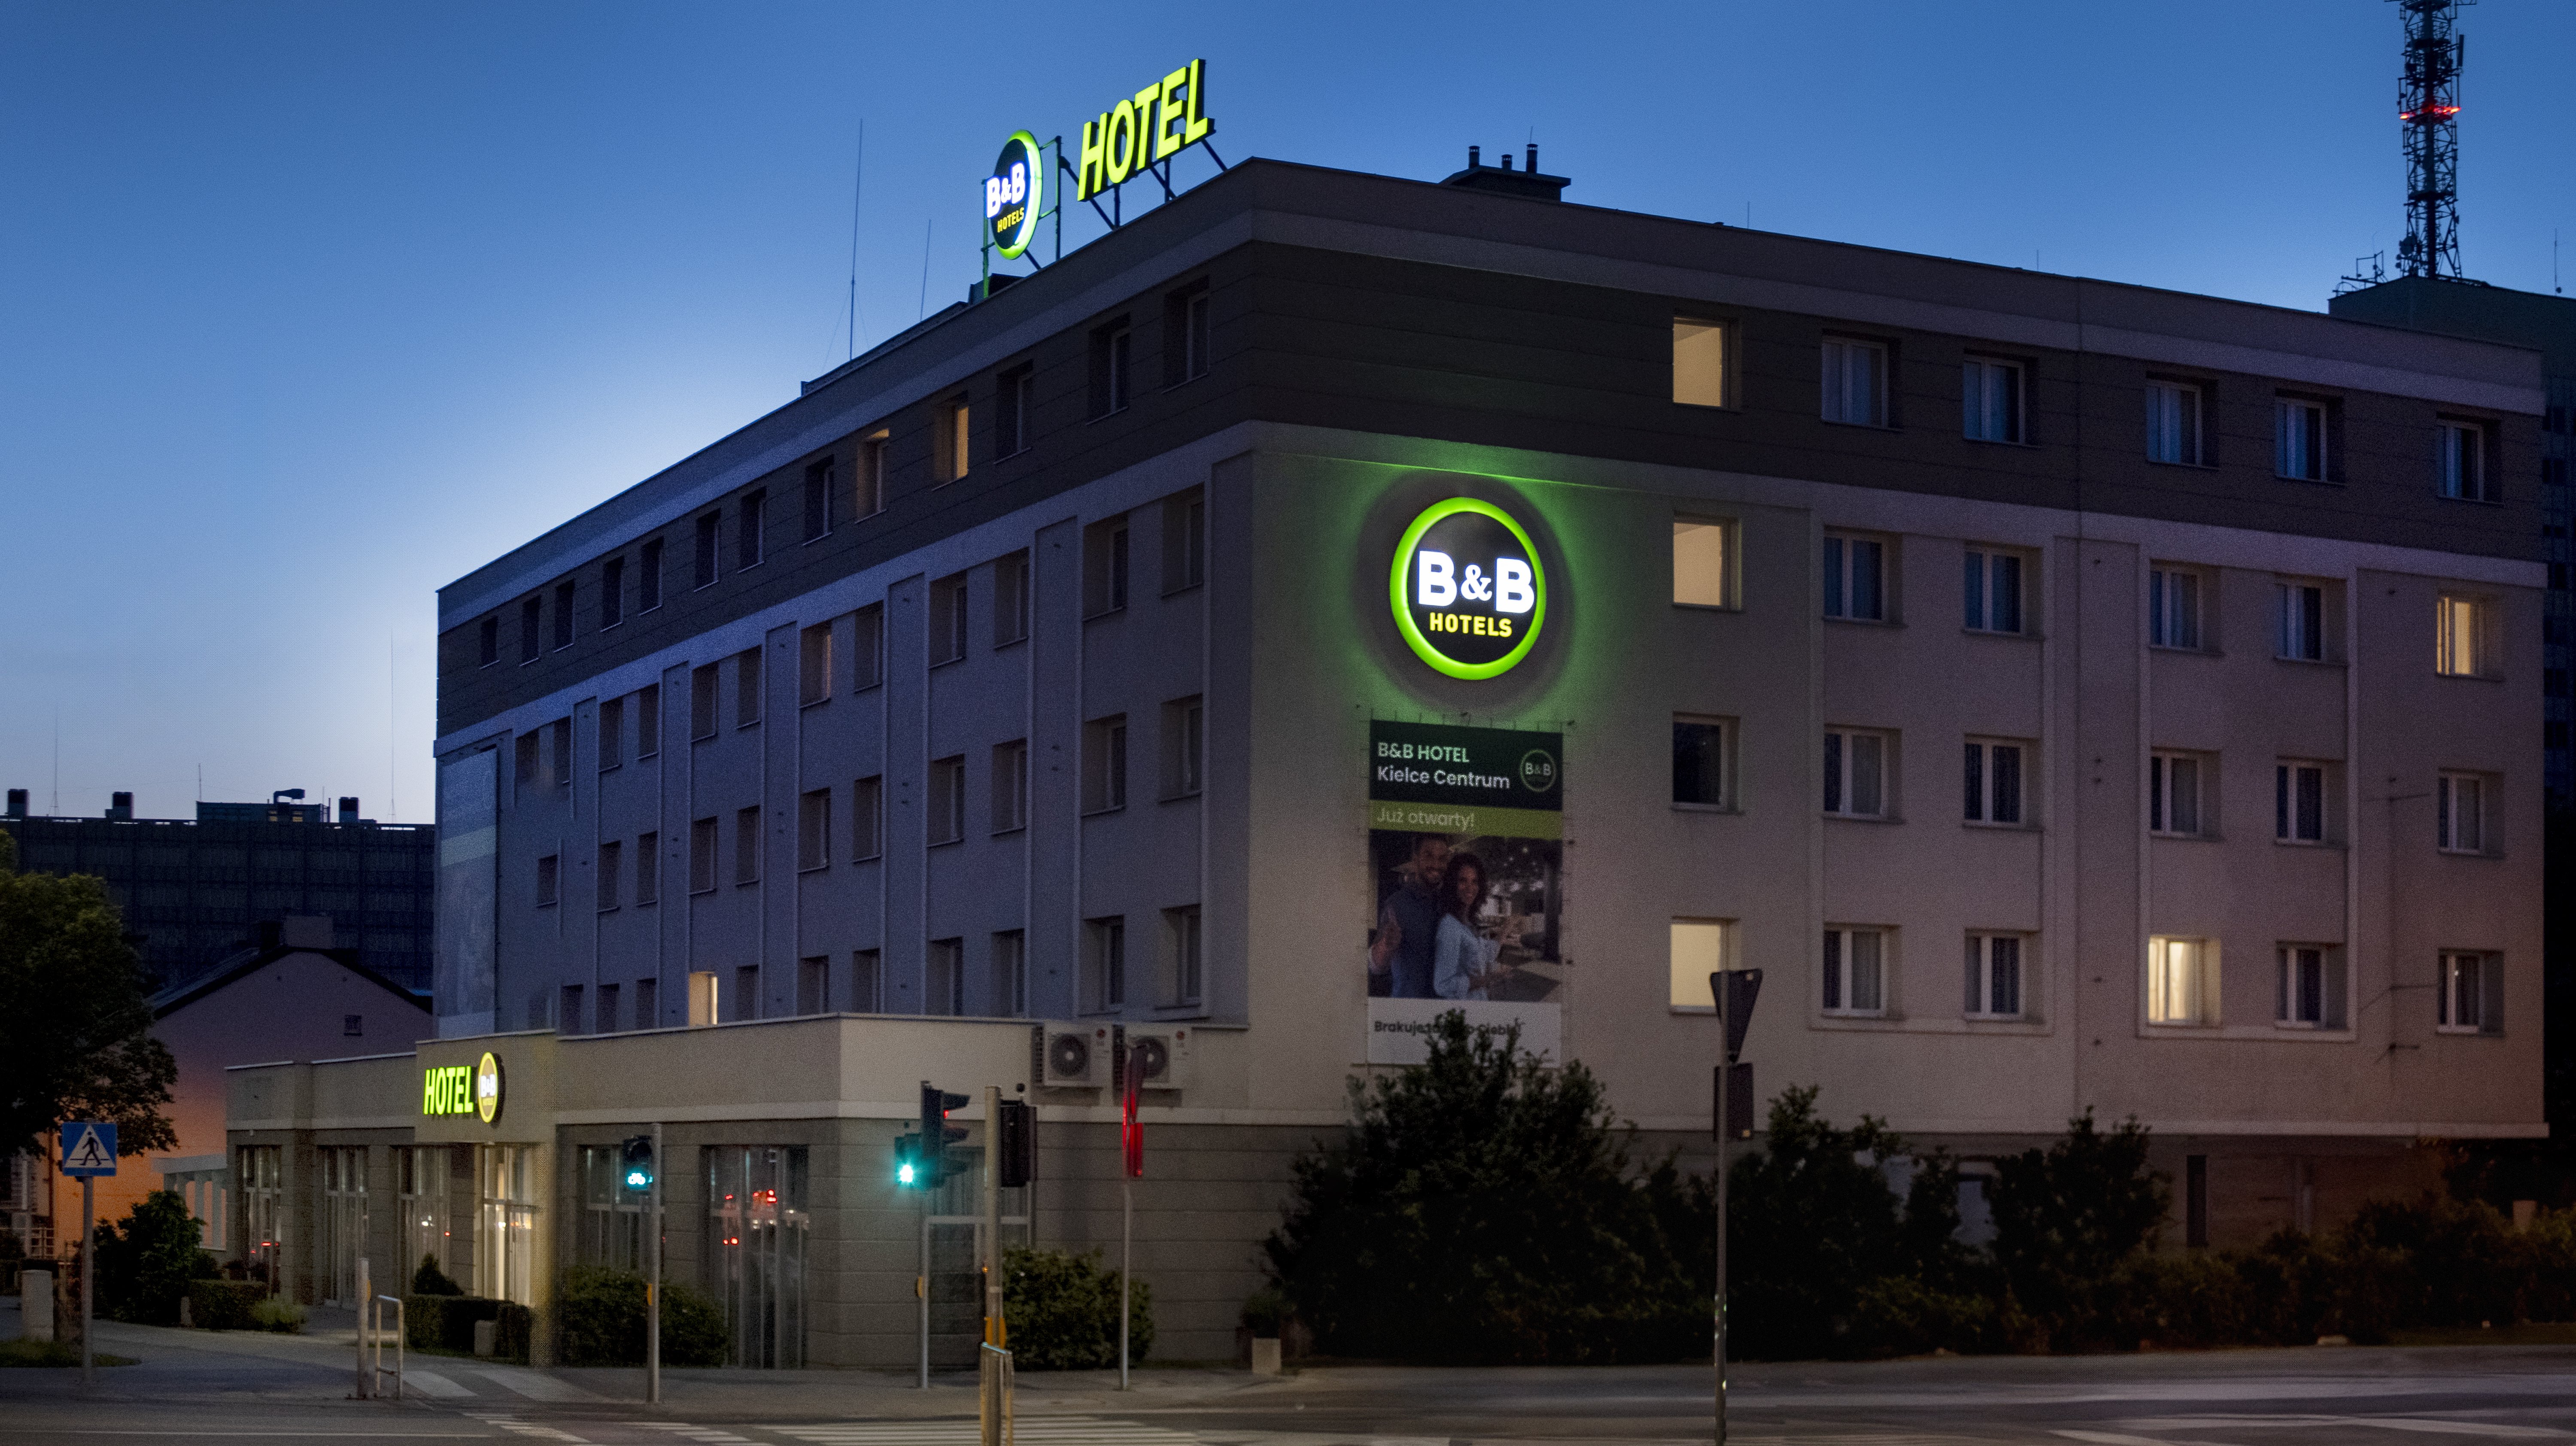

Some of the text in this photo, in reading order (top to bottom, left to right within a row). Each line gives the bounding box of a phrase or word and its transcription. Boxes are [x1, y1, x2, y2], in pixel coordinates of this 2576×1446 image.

[1077, 58, 1209, 201] HOTEL
[986, 162, 1026, 218] B&B
[997, 207, 1025, 233] HOTELS
[1419, 550, 1534, 614] B&B
[1430, 612, 1512, 637] HOTELS
[1378, 742, 1470, 763] B&B HOTEL
[1377, 765, 1510, 789] Kielce Centrum
[1525, 762, 1552, 776] B&B
[1377, 808, 1474, 832] Już otwarty!
[423, 1066, 474, 1115] HOTEL
